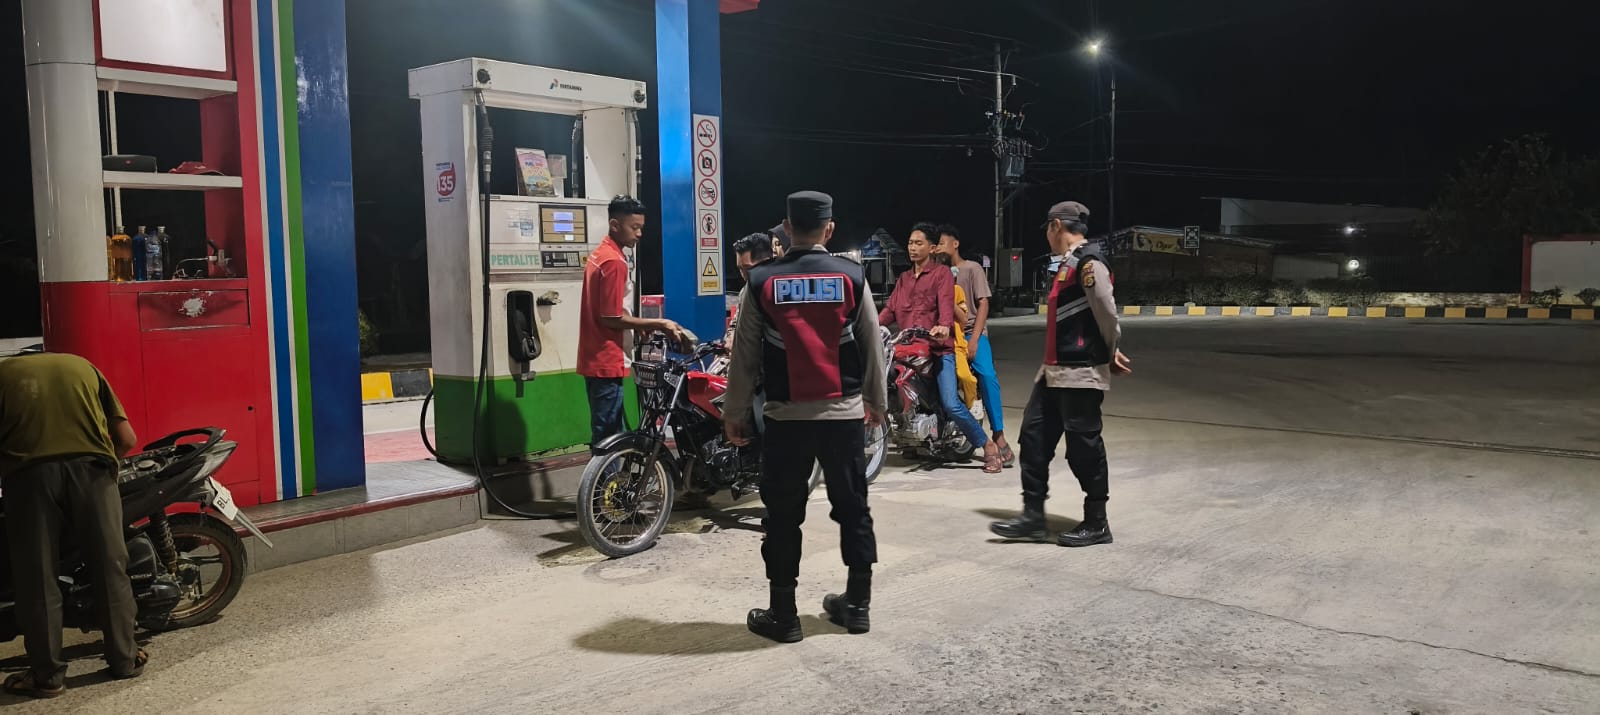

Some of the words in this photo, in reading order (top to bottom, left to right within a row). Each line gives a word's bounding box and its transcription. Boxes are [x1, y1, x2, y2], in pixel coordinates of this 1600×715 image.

[437, 175, 454, 192] 135
[490, 254, 540, 266] PERTALITE
[777, 277, 843, 302] POLISI
[217, 496, 228, 508] BL
